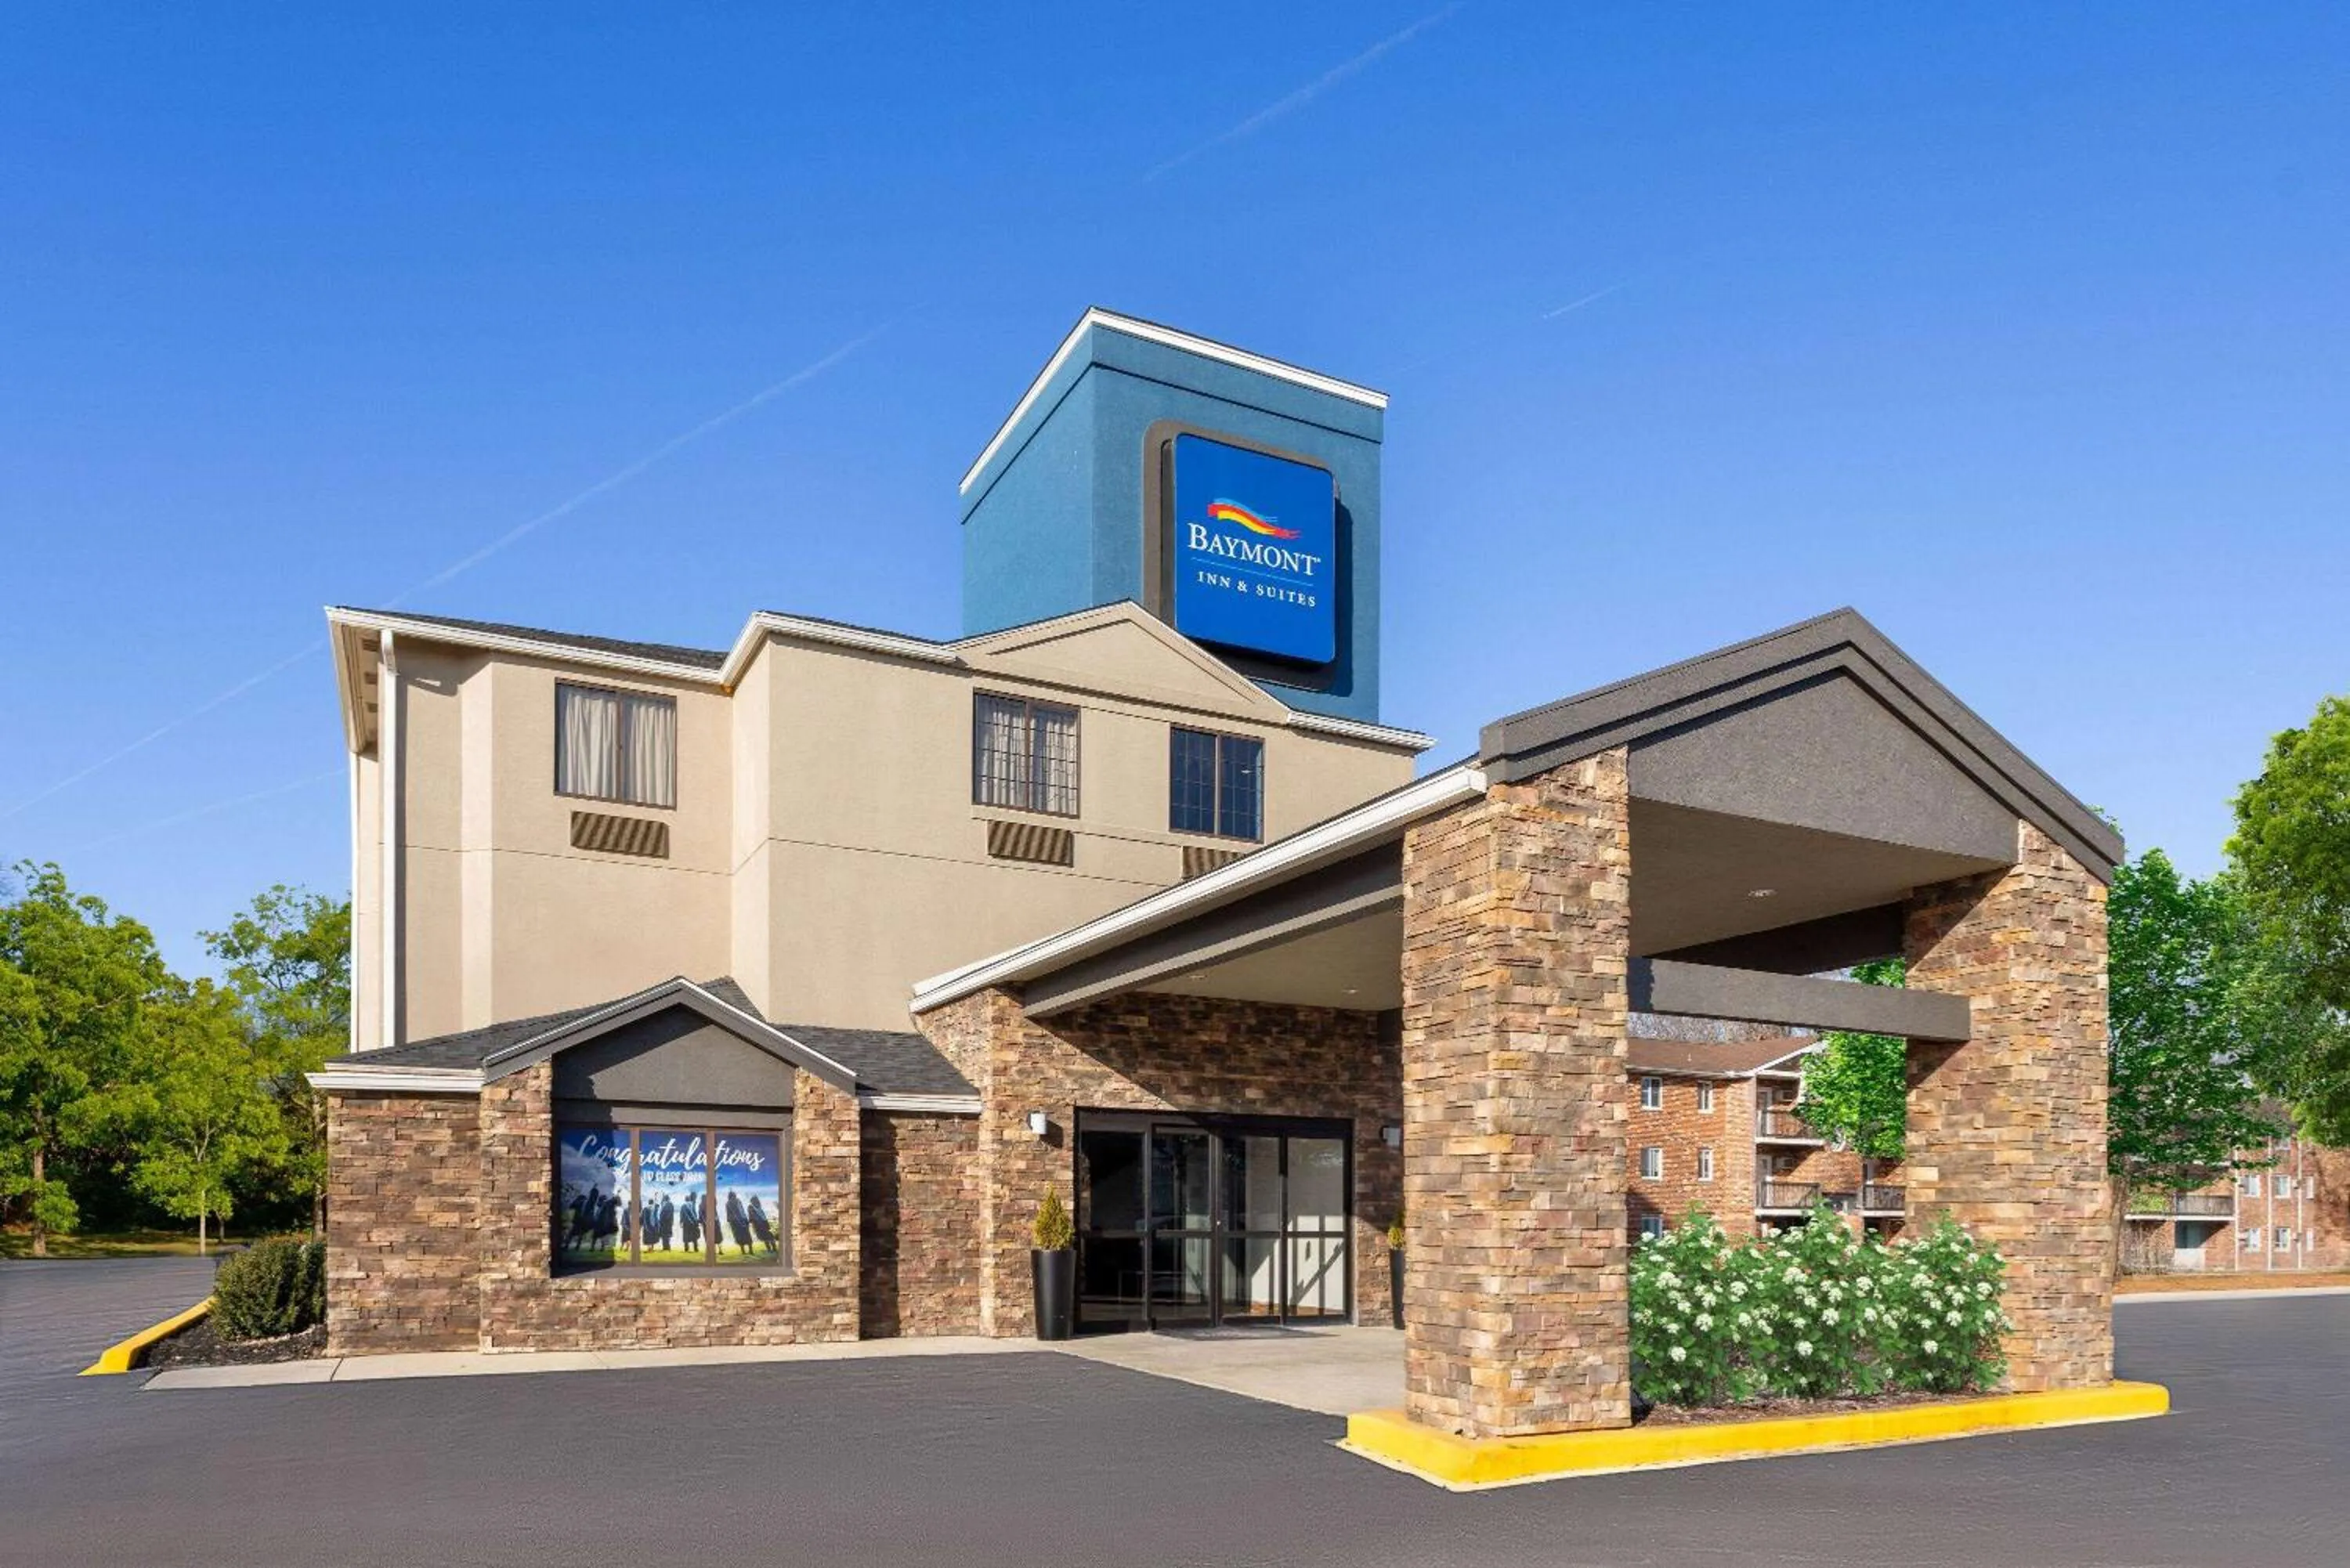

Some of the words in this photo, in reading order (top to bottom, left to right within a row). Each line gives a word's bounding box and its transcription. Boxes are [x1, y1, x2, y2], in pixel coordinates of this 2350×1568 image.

[1188, 522, 1316, 576] BAYMONT
[1198, 571, 1231, 588] INN
[1237, 580, 1247, 593] &
[1256, 583, 1316, 608] SUITES
